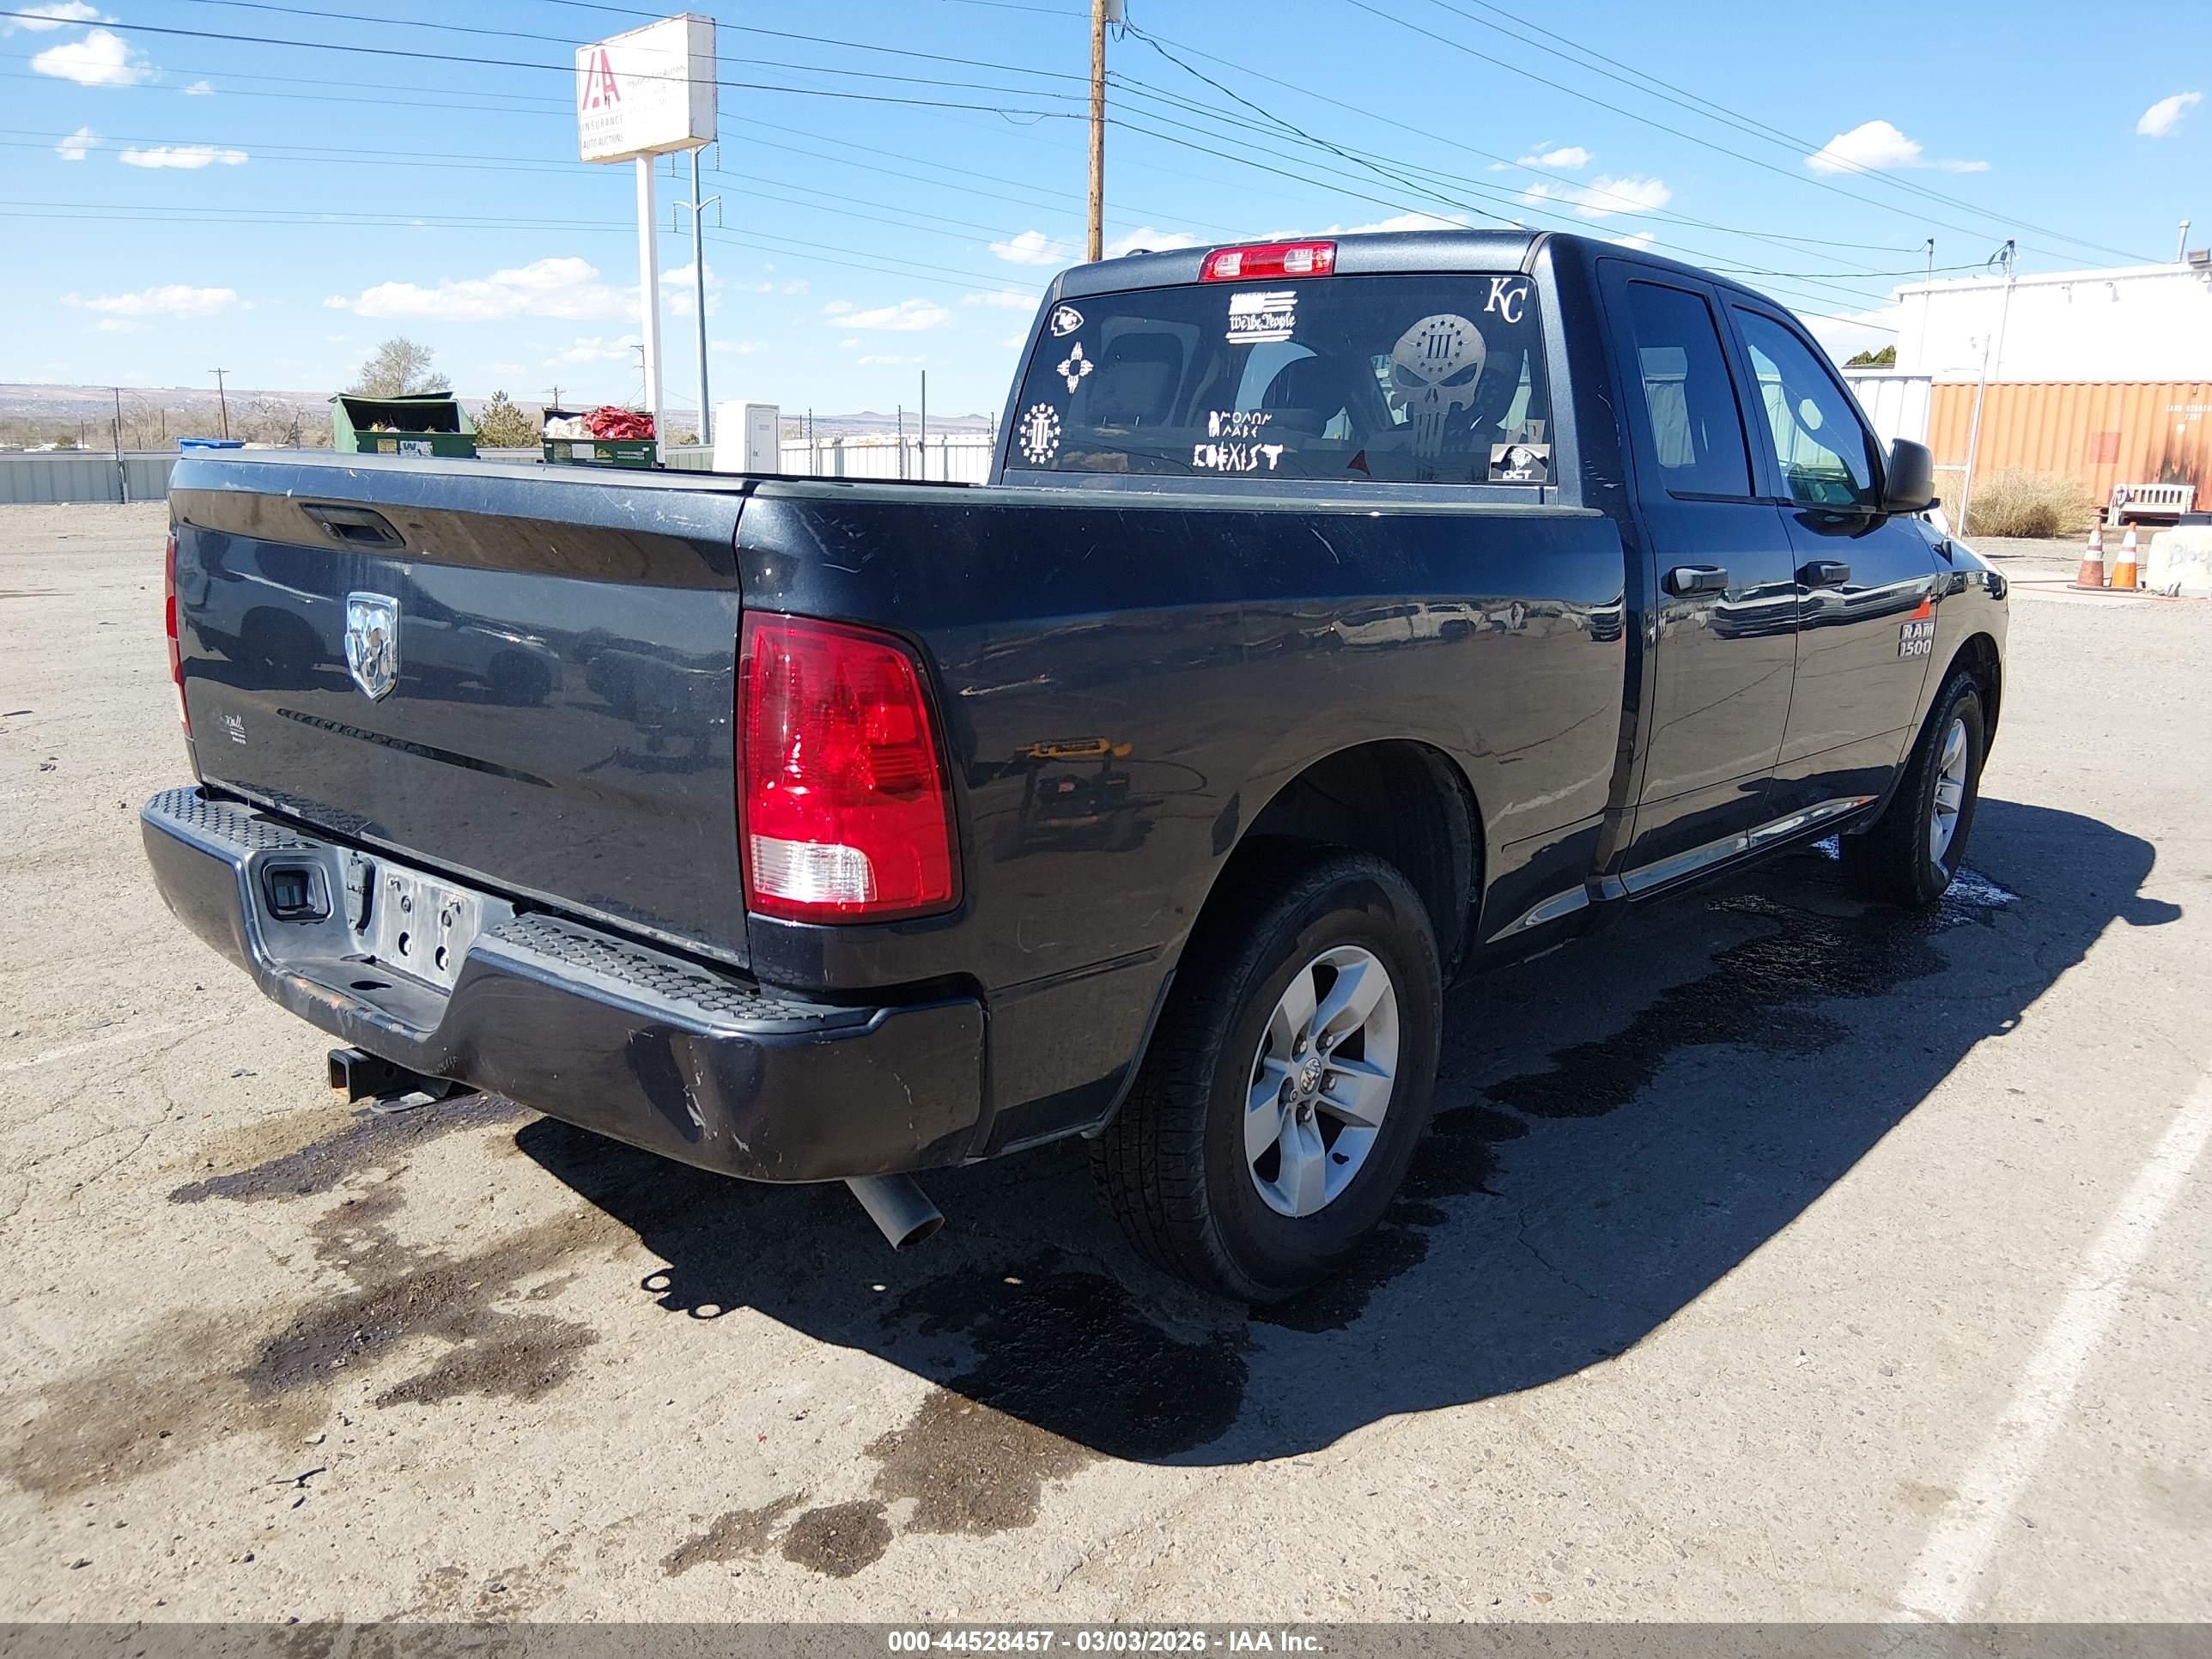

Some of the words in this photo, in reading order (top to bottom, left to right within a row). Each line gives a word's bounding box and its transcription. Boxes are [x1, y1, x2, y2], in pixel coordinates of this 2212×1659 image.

[1484, 277, 1528, 324] KC
[1262, 312, 1297, 331] People
[1900, 623, 1935, 640] RAM
[1898, 640, 1932, 658] 1500
